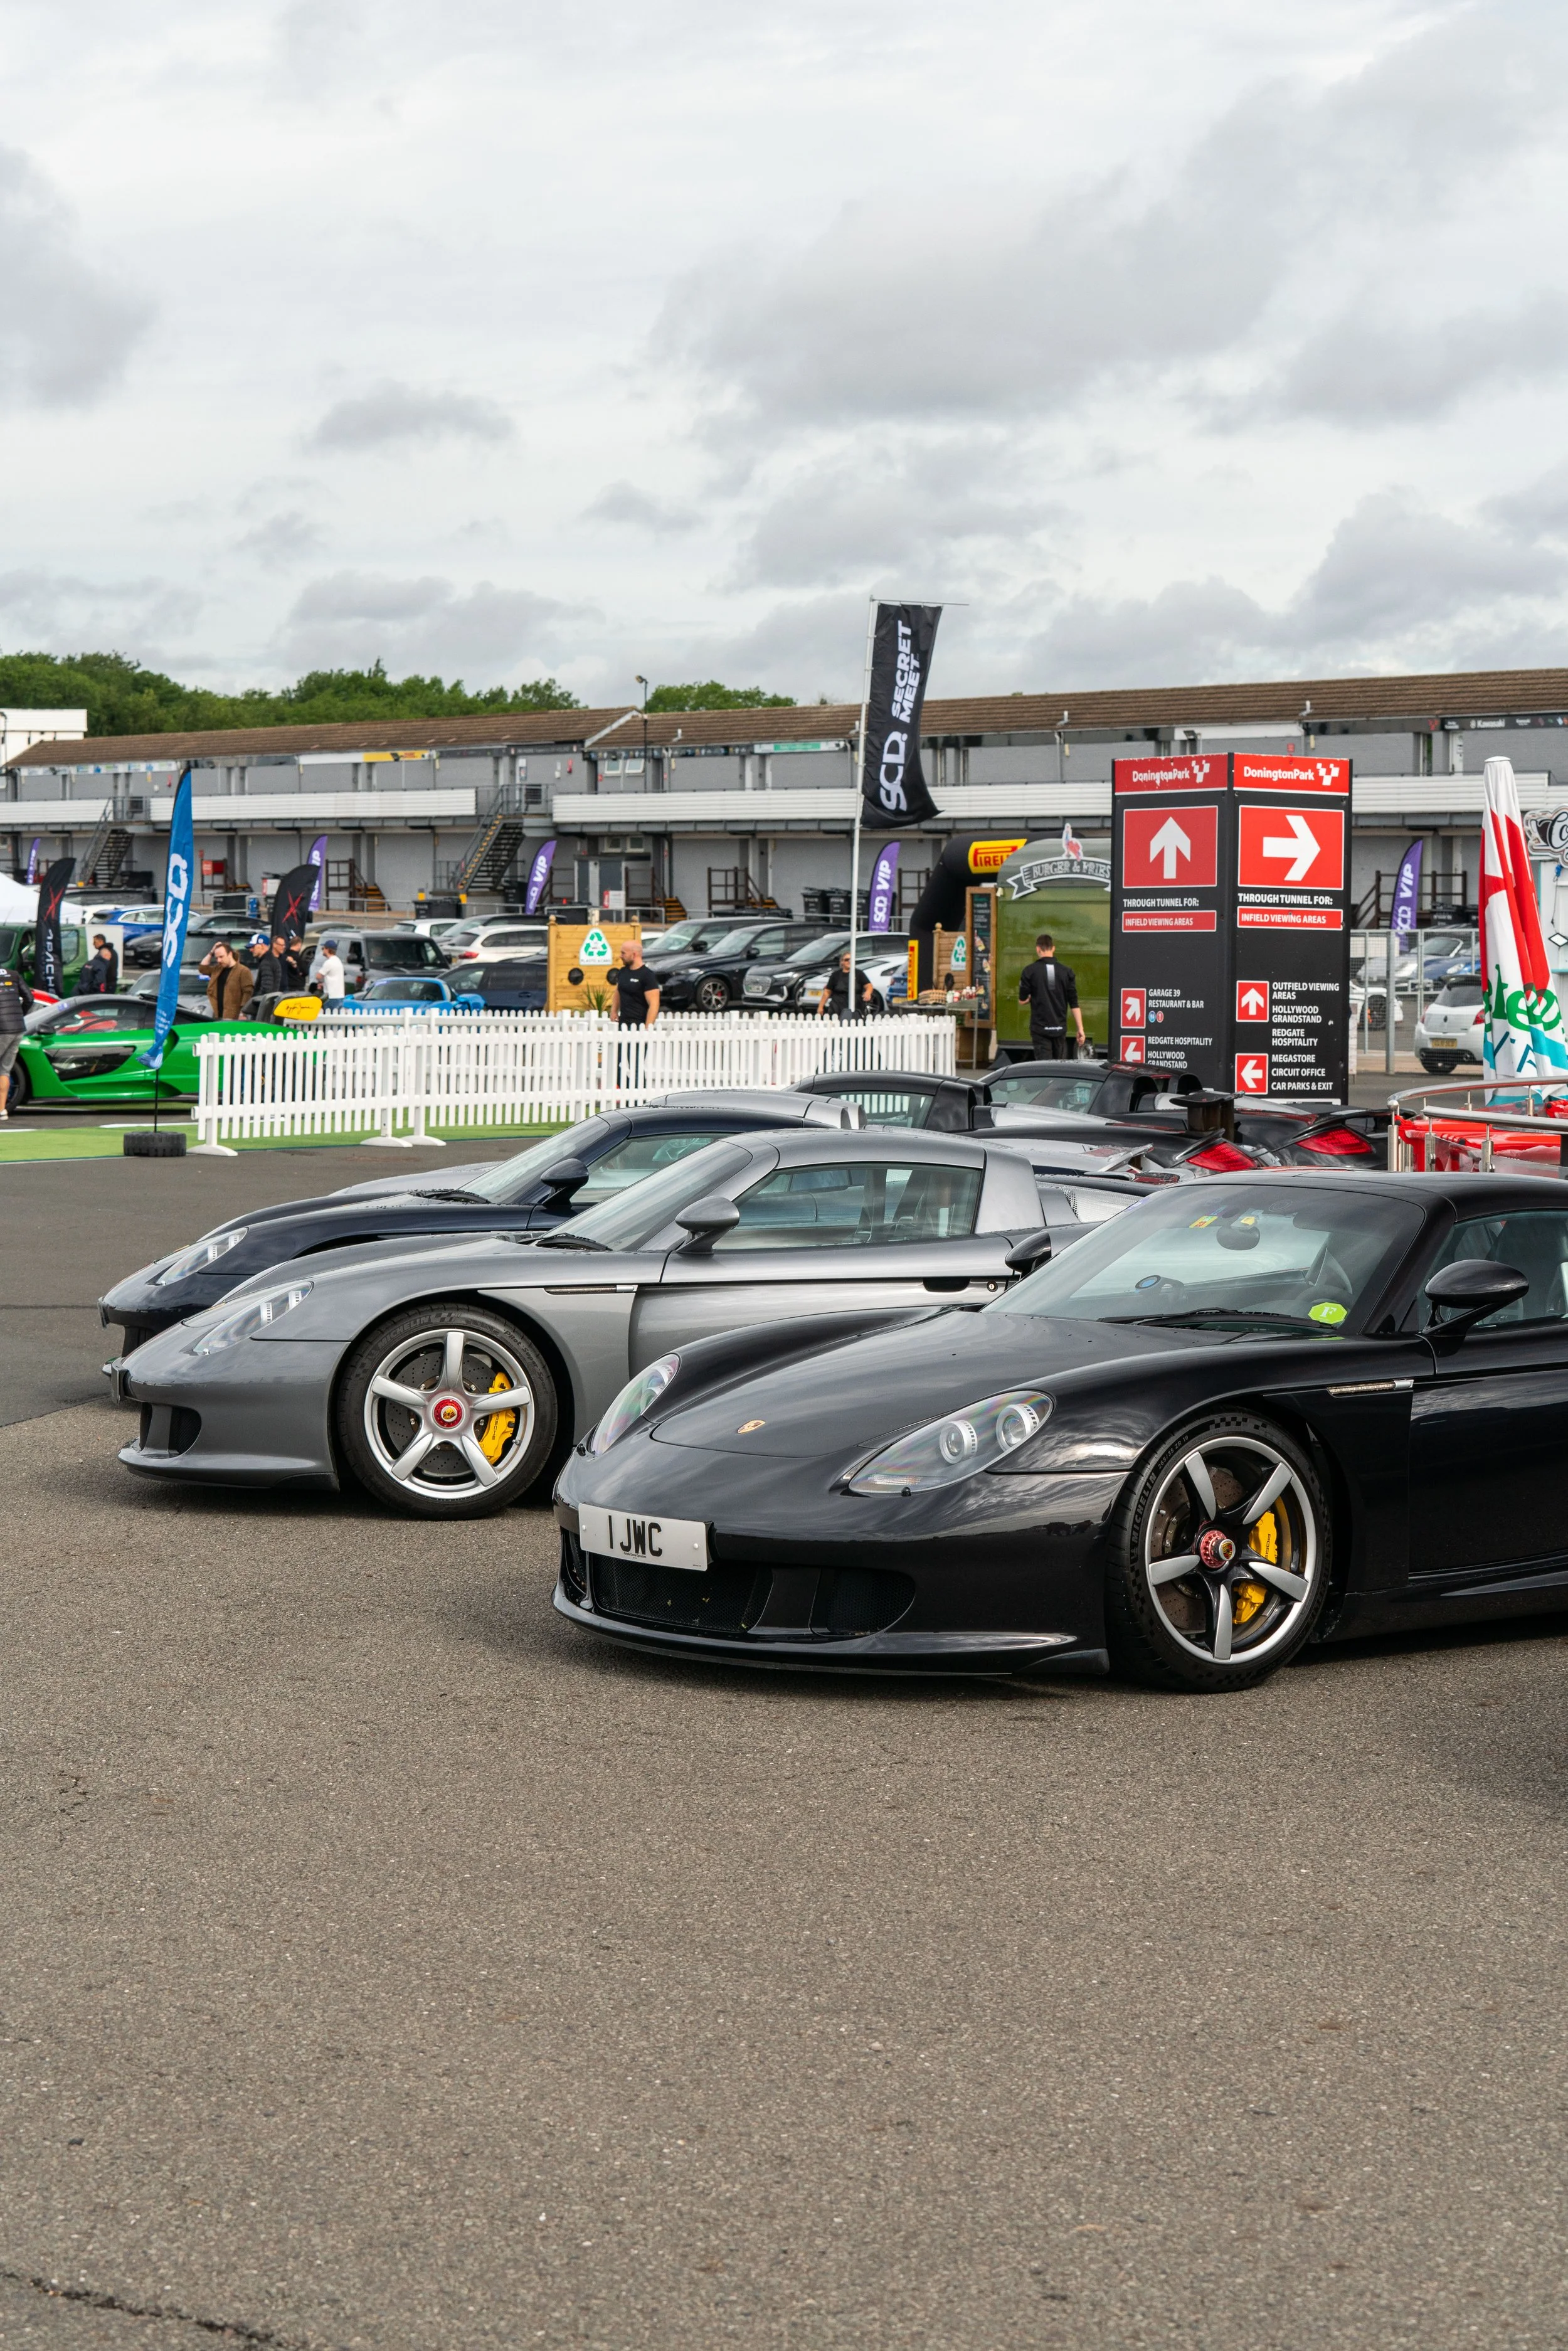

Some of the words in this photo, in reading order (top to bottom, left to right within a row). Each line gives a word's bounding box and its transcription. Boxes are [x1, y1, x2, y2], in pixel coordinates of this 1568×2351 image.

[892, 620, 911, 718] SECRET
[899, 653, 920, 724] MEET
[1244, 766, 1315, 782] DoningtonPark
[533, 856, 547, 882] VIP
[876, 860, 891, 890] VIP
[1032, 861, 1070, 878] BURGER
[1082, 862, 1111, 878] FRIES
[1399, 863, 1414, 899] VIP
[1123, 899, 1155, 908] THROUGH
[1157, 898, 1182, 907] TUNNEL
[1184, 898, 1199, 907] FOR:
[1238, 893, 1278, 904] THROUGH
[1280, 894, 1312, 905] TUNNEL
[1314, 896, 1333, 905] FOR:
[1125, 918, 1147, 926] INFIELD
[1148, 918, 1173, 926] VIEWING
[1174, 918, 1193, 926] AREAS
[1241, 913, 1269, 922] INFIELD
[1271, 914, 1301, 923] VIEWING
[1303, 915, 1326, 923] AREAS
[1272, 982, 1308, 990] OUTFIELD
[1309, 983, 1339, 991] VIEWING
[1148, 1000, 1186, 1008] RESTAURANT
[1272, 1006, 1318, 1014] HOLLYWOOD
[1272, 1015, 1322, 1023] GRANDSTAND
[1272, 1029, 1305, 1037] REDGATE
[1148, 1036, 1173, 1044] REDGATE
[1175, 1037, 1212, 1046] HOSPITALITY
[1272, 1038, 1318, 1046] HOSPITALITY
[1148, 1051, 1185, 1059] HOLLYWOOD
[1271, 1068, 1300, 1076] CIRCUIT
[1301, 1068, 1325, 1076] OFFICE
[1271, 1082, 1286, 1090] CAR
[1288, 1082, 1310, 1090] PARKS
[1311, 1082, 1316, 1090] &
[1318, 1082, 1333, 1090] EXIT
[378, 1316, 432, 1349] MICHELIN
[504, 1329, 522, 1345] Pilot
[492, 1412, 500, 1440] ORSCHE
[1158, 1448, 1174, 1469] 265/35
[1131, 1473, 1157, 1544] MICHELIN
[620, 1518, 662, 1557] JWC
